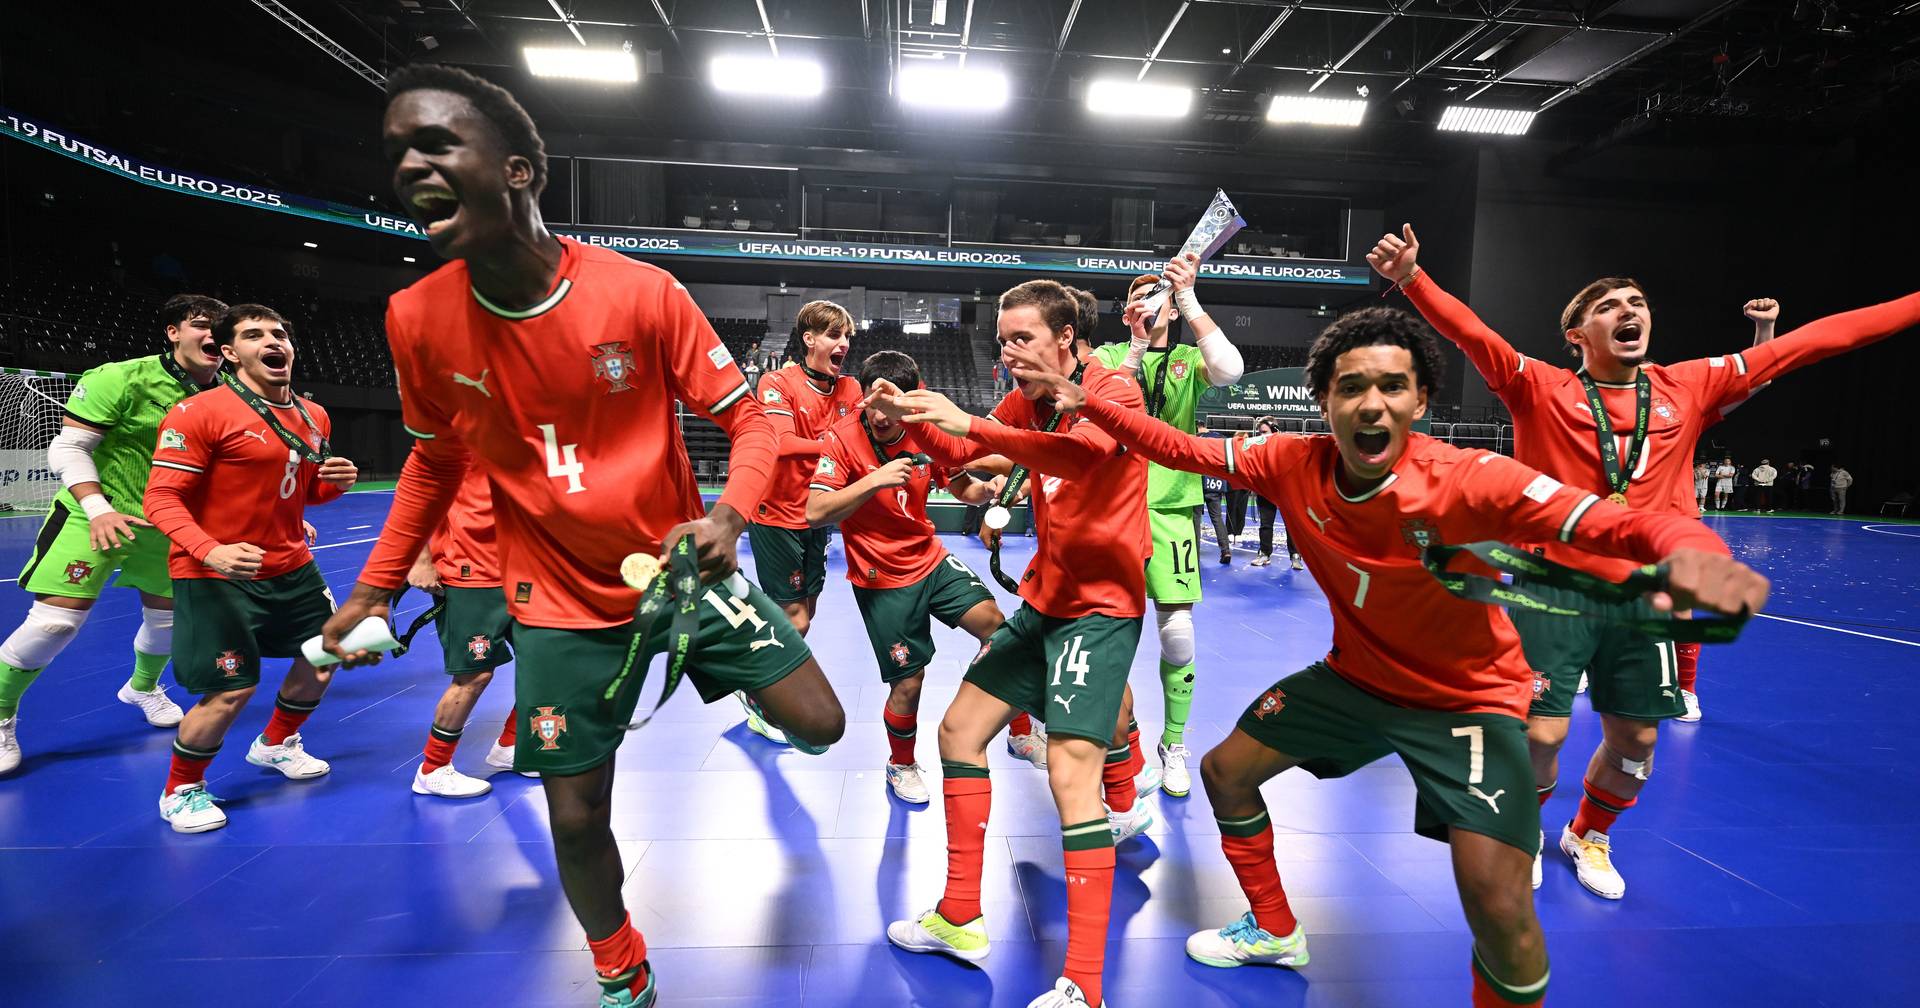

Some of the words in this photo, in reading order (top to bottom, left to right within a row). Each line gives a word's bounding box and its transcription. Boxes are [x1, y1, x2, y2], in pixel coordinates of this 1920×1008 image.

[42, 128, 138, 176] FUTSAL
[139, 165, 218, 193] EURO
[364, 213, 420, 235] UEFA
[589, 235, 638, 248] EURO
[639, 237, 679, 250] 2025
[738, 242, 783, 254] UEFA
[784, 244, 868, 258] UNDER-19
[869, 248, 936, 261] FUTSAL
[936, 251, 983, 263] EURO
[983, 252, 1022, 265] 2025
[1076, 257, 1118, 270] UEFA
[1199, 264, 1261, 276] FUTSAL
[1262, 266, 1305, 278] EURO
[1306, 269, 1341, 279] 2025
[1234, 315, 1251, 327] 201
[1227, 402, 1246, 411] UEFA
[1246, 403, 1283, 412] UNDER-19
[537, 424, 588, 494] 4
[0, 469, 20, 487] p
[1009, 468, 1025, 493] MOLDOVA
[1170, 539, 1195, 574] 12
[1346, 562, 1371, 609] 7
[701, 588, 768, 634] 4
[1050, 635, 1091, 687] 14
[1451, 725, 1484, 784] 7
